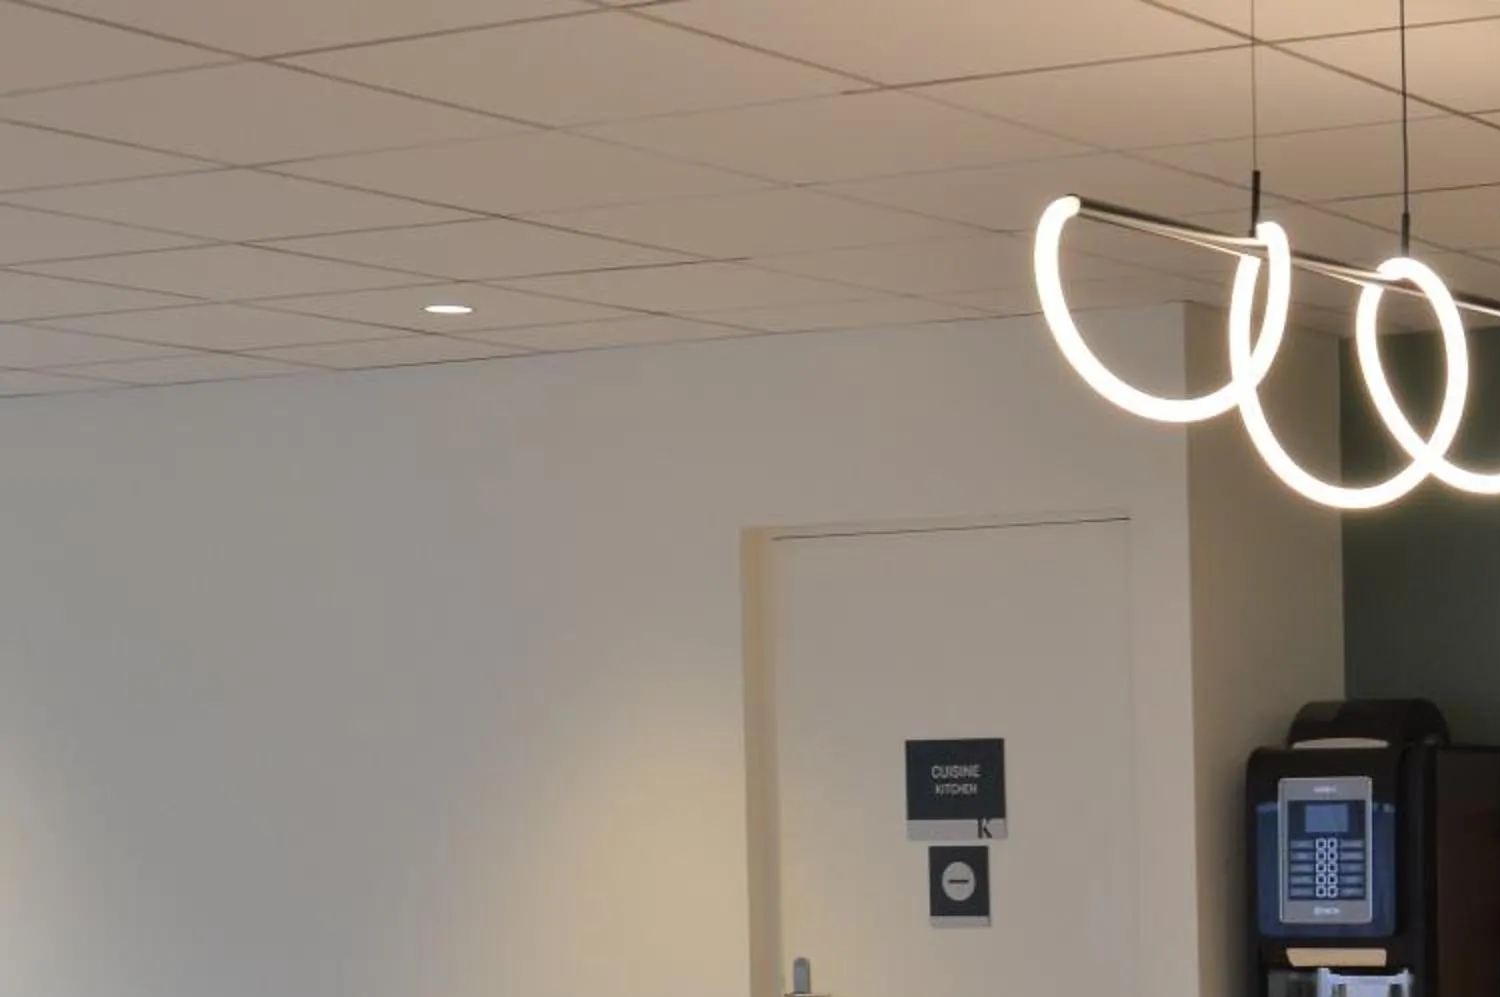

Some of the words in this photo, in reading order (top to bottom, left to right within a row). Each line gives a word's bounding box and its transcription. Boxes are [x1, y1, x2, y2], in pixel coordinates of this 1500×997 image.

[931, 764, 981, 779] CUISINE
[935, 783, 978, 795] KITCHEN
[977, 817, 993, 839] K
